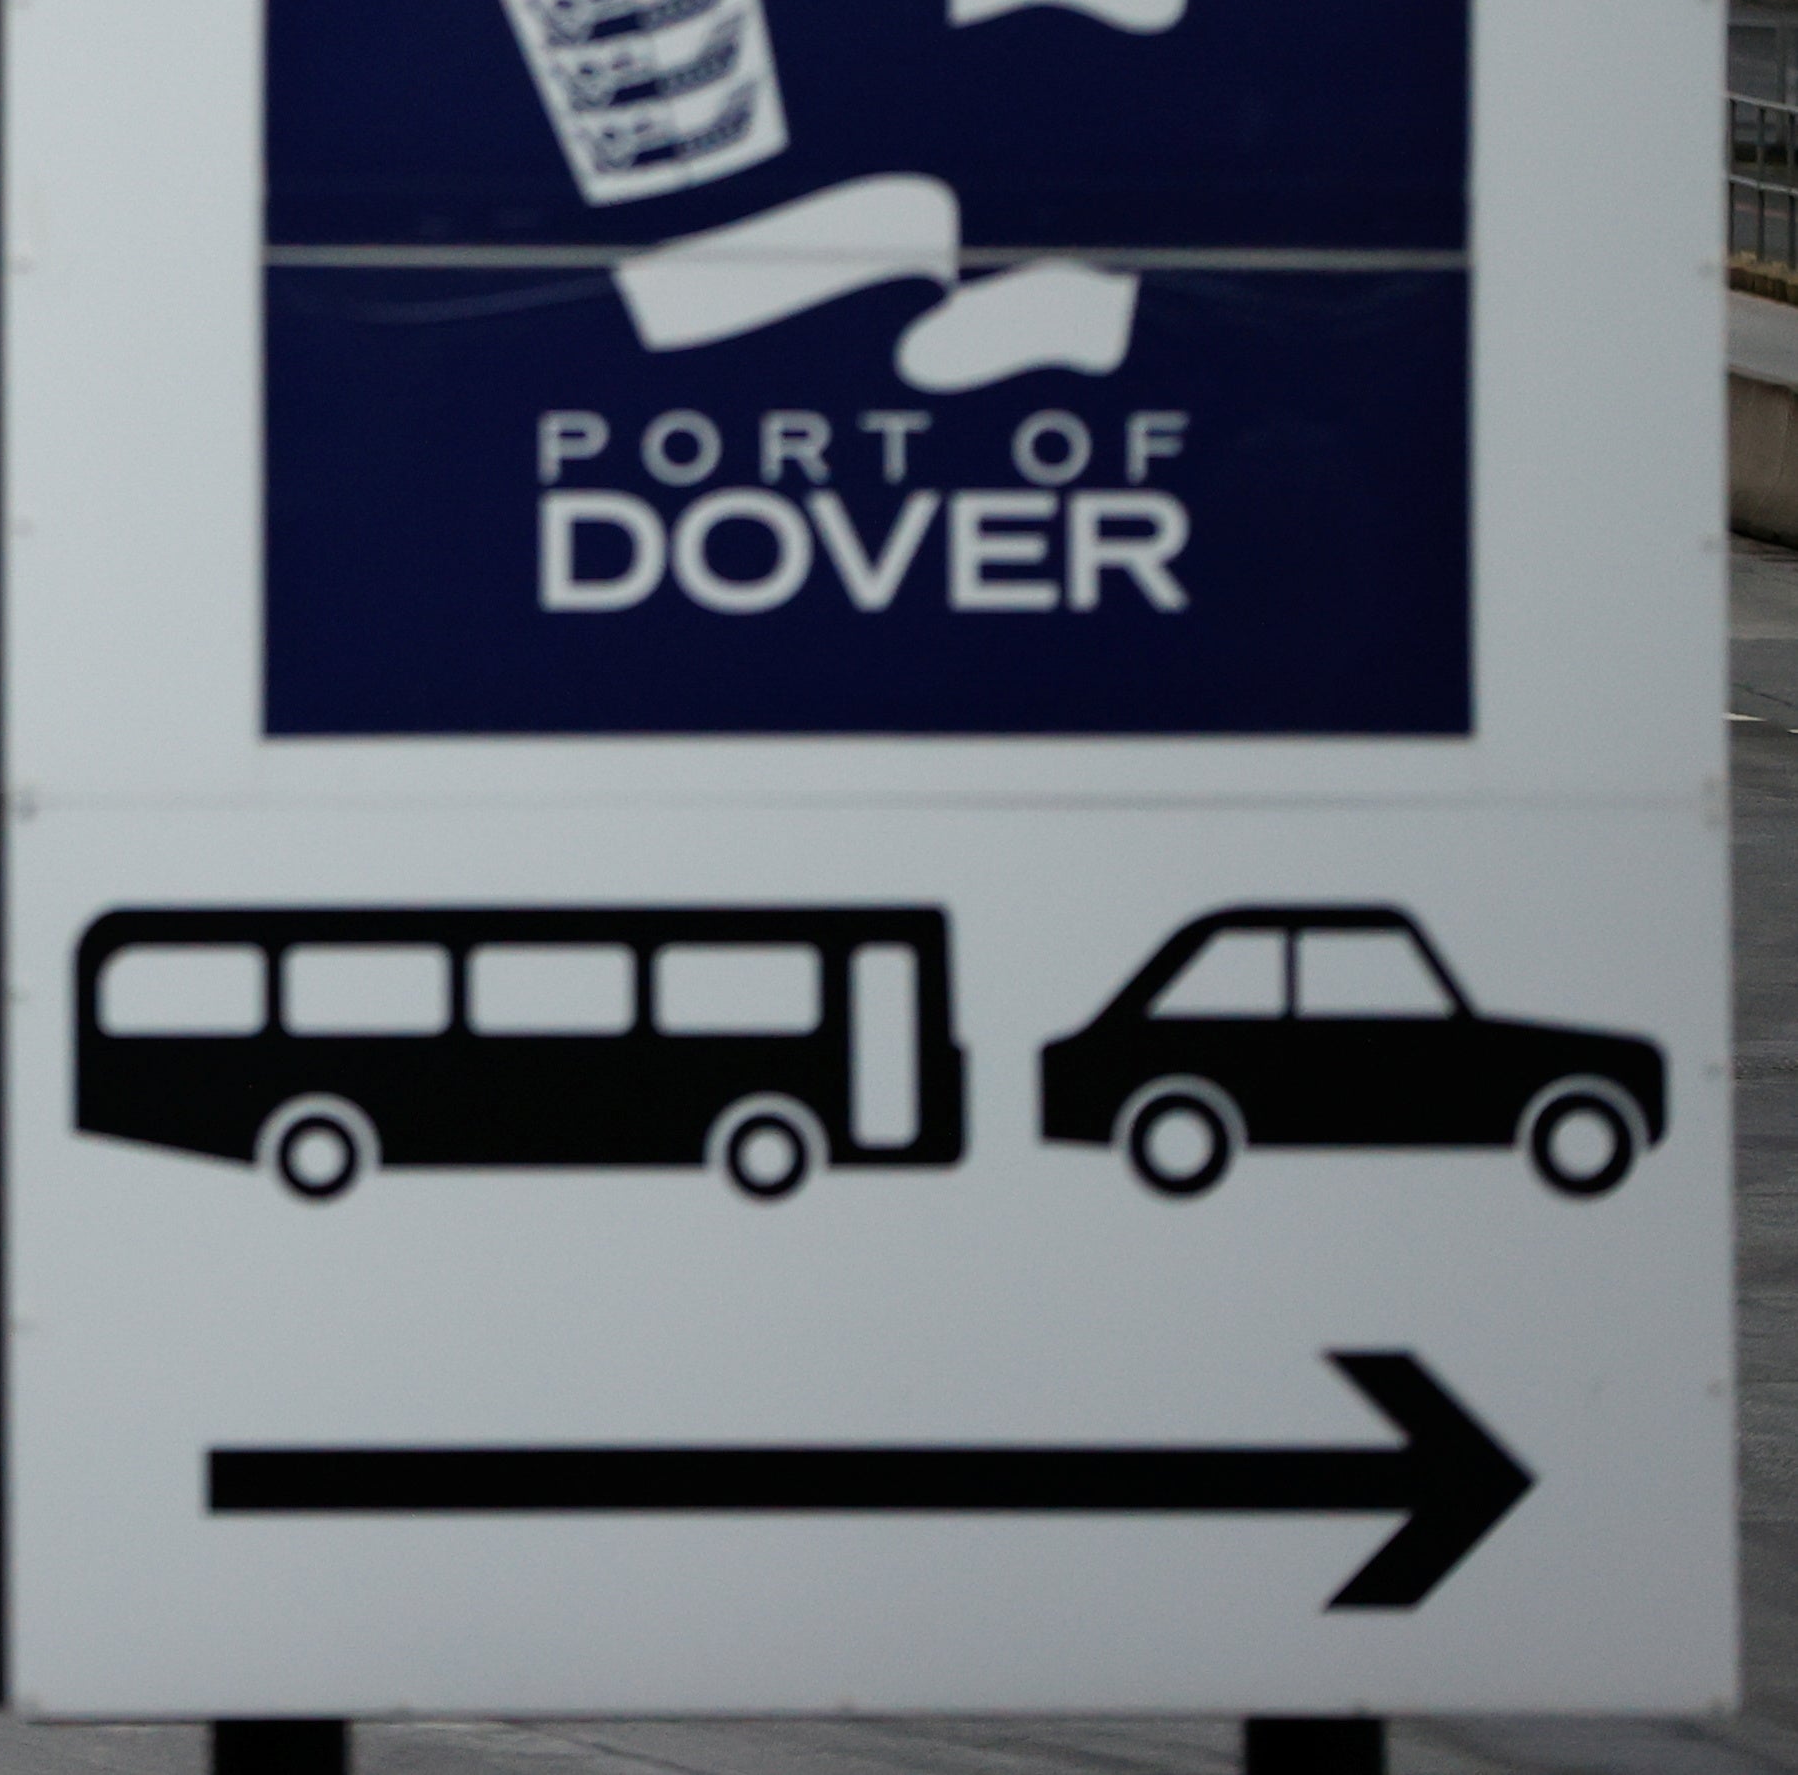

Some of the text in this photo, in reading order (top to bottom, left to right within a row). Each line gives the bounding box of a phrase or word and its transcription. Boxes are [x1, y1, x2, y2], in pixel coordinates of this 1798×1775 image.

[536, 408, 1192, 487] PORT OF
[536, 485, 1192, 616] DOVER
